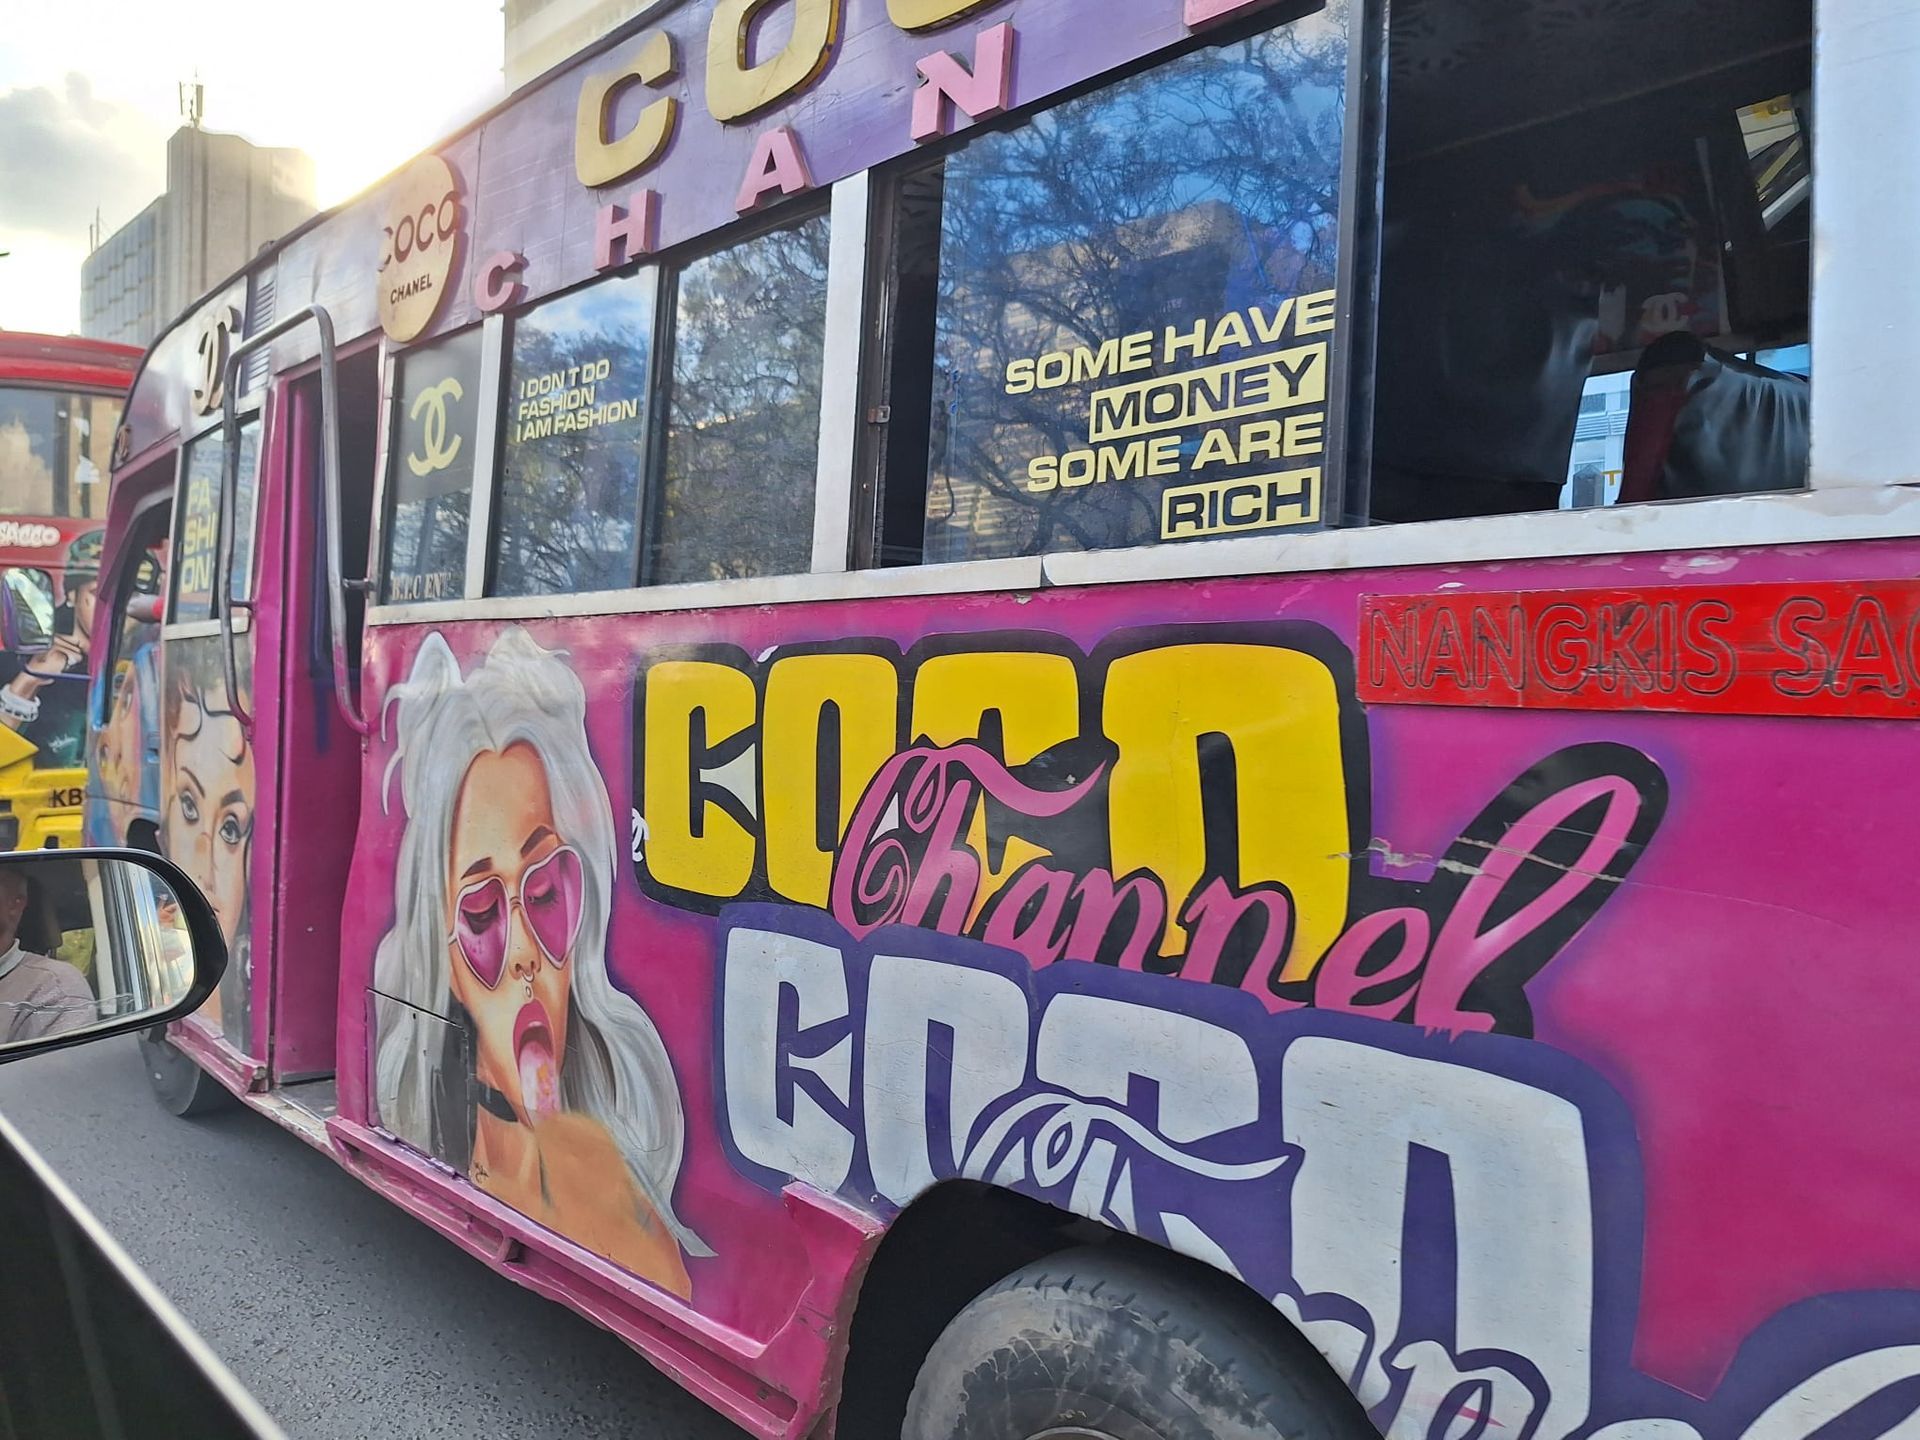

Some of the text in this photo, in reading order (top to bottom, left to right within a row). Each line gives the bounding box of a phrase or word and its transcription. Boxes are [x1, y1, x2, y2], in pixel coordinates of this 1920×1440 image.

[390, 273, 433, 304] CHANEL
[1005, 289, 1336, 395] SOME HAVE
[518, 385, 596, 422] FASHION
[519, 381, 526, 400] I
[582, 359, 610, 384] DO
[1094, 351, 1319, 435] MONEY
[516, 398, 638, 442] I AM FASHION
[1027, 412, 1325, 492] SOME ARE
[1167, 476, 1312, 533] RICH
[1369, 595, 1920, 698] NANGKIS SA
[831, 745, 1641, 1042] Channel
